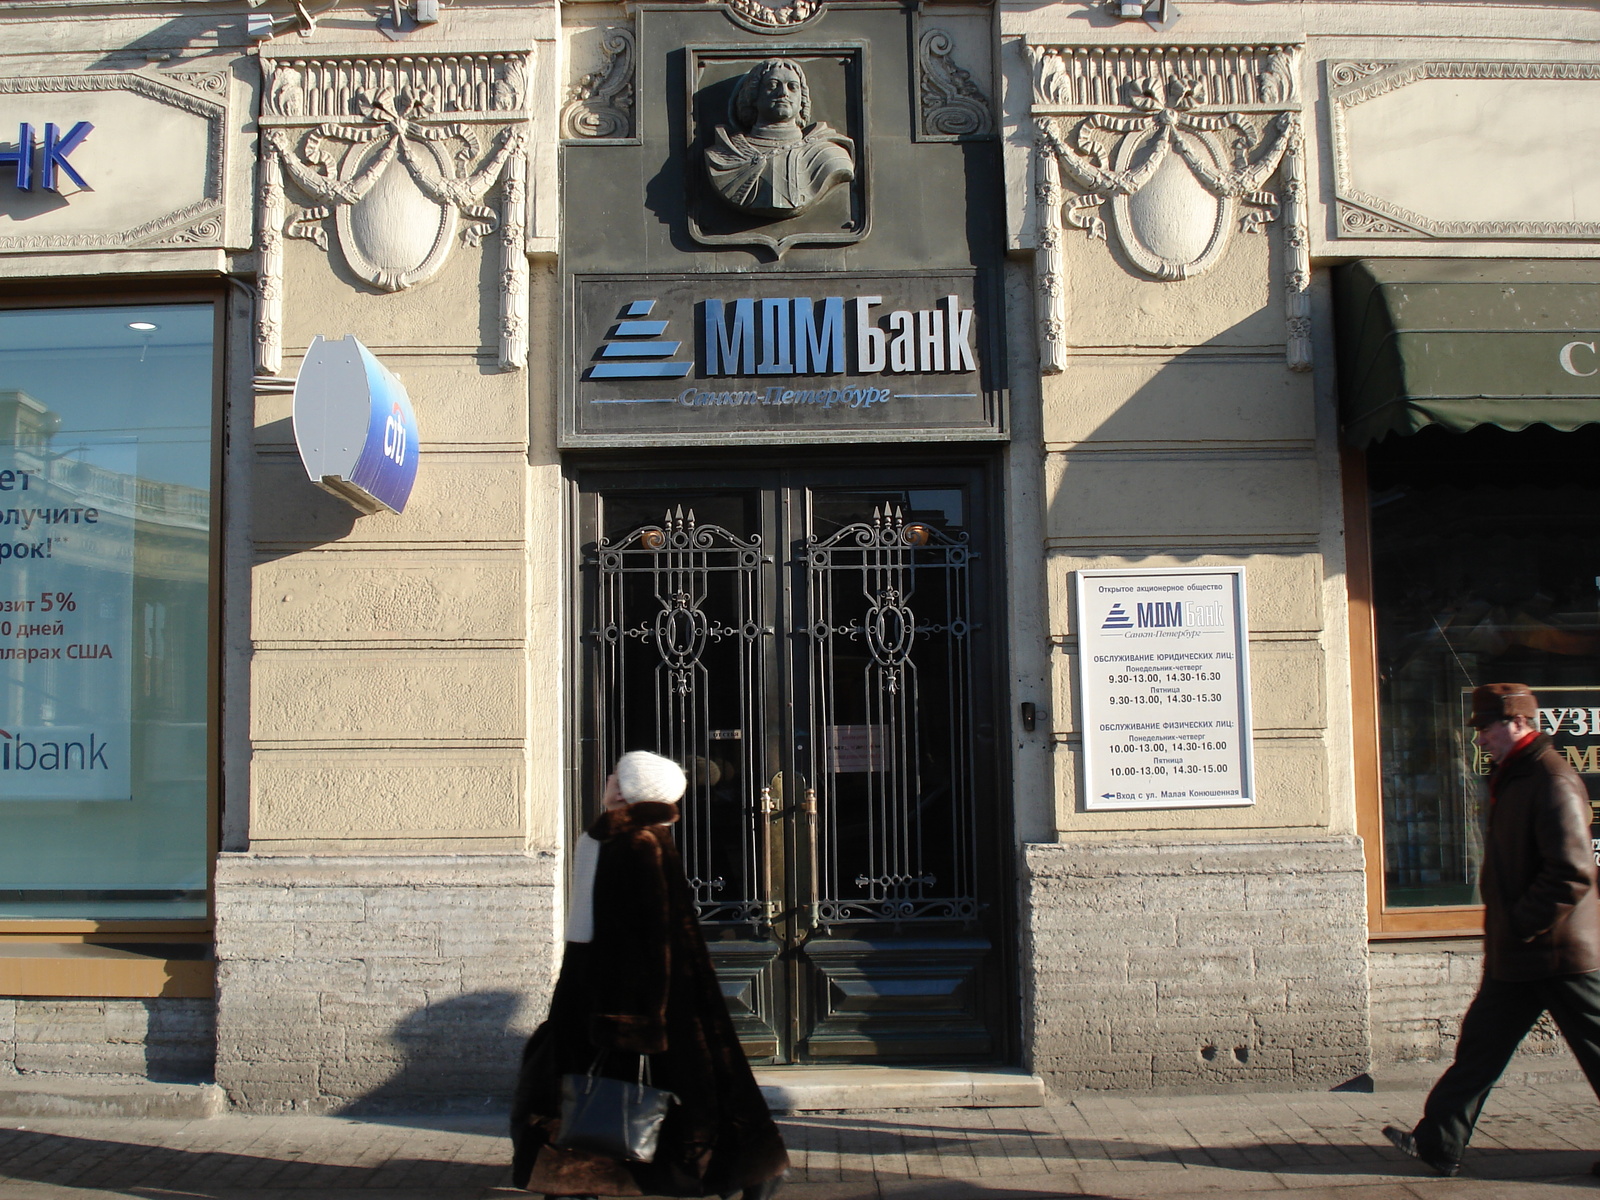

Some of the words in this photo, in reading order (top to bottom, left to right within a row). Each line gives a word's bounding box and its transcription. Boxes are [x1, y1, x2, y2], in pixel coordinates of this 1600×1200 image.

[704, 296, 844, 376] МДМ
[856, 294, 977, 373] Банк
[678, 384, 890, 408] Санкт-Петербург
[384, 415, 406, 466] citi
[1098, 585, 1134, 593] Открытое
[1136, 584, 1185, 592] акционерное
[1187, 583, 1223, 591] общество
[41, 592, 76, 612] 5%
[1137, 601, 1182, 628] МДМ
[1185, 600, 1225, 627] Банк
[0, 621, 12, 635] 0
[16, 619, 64, 638] дней
[1124, 629, 1202, 640] Санкт-Петербург
[66, 645, 113, 659] США
[1093, 654, 1154, 663] ОБСЛУЖИВАНИЕ
[1156, 653, 1214, 662] ЮРИДИЧЕСКИХ
[1215, 652, 1235, 660] ЛИЦ:
[1125, 665, 1203, 673] Понедельник-четверг
[1108, 674, 1162, 684] 9.30-13.00,
[1166, 672, 1221, 682] 14.30-16.30
[1109, 695, 1163, 705] 9.30-13.00,
[1167, 693, 1222, 703] 14.30-15.30
[1100, 722, 1160, 731] ОБСЛУЖИВАНИЕ
[1162, 721, 1213, 730] ФИЗИЧЕСКИХ
[1215, 720, 1235, 728] ЛИЦ:
[1128, 734, 1206, 742] Понедельник-четверг
[1109, 744, 1168, 753] 10.00-13.00,
[1172, 741, 1227, 751] 14.30-16.00
[1153, 757, 1183, 765] Пятница
[1110, 766, 1169, 776] 10.00-13.00,
[1173, 764, 1228, 774] 14.30-15.00
[1116, 792, 1136, 800] Вход
[1160, 790, 1186, 798] Малая
[1189, 789, 1239, 797] Конюшенная
